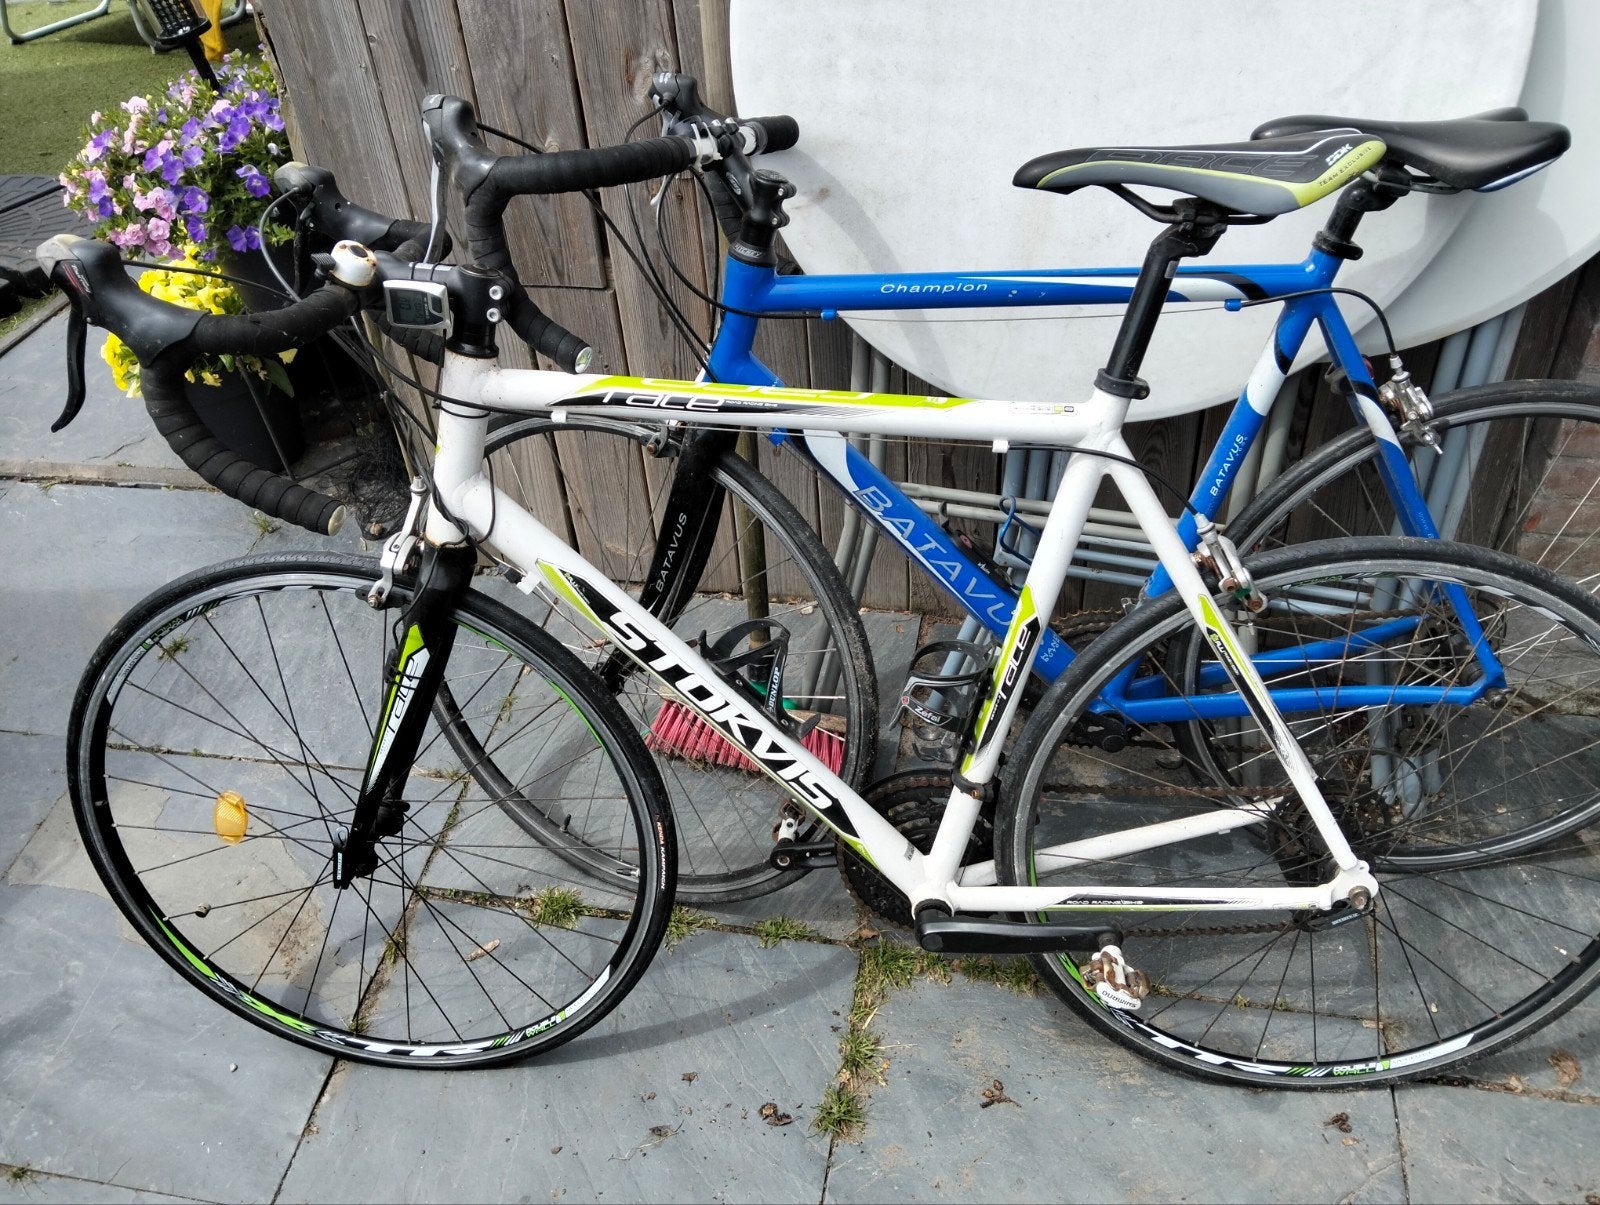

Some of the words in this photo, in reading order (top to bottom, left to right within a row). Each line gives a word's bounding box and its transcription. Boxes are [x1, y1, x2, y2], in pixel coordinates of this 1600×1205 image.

[880, 283, 988, 295] Champion
[602, 391, 725, 412] race
[1209, 434, 1244, 497] BATAVUS
[655, 512, 687, 592] BATAVUS
[855, 485, 1044, 646] BATAVU
[768, 666, 780, 708] DUNLOP
[998, 624, 1031, 700] race
[609, 611, 833, 810] STOKVIS
[656, 821, 665, 845] KENDA
